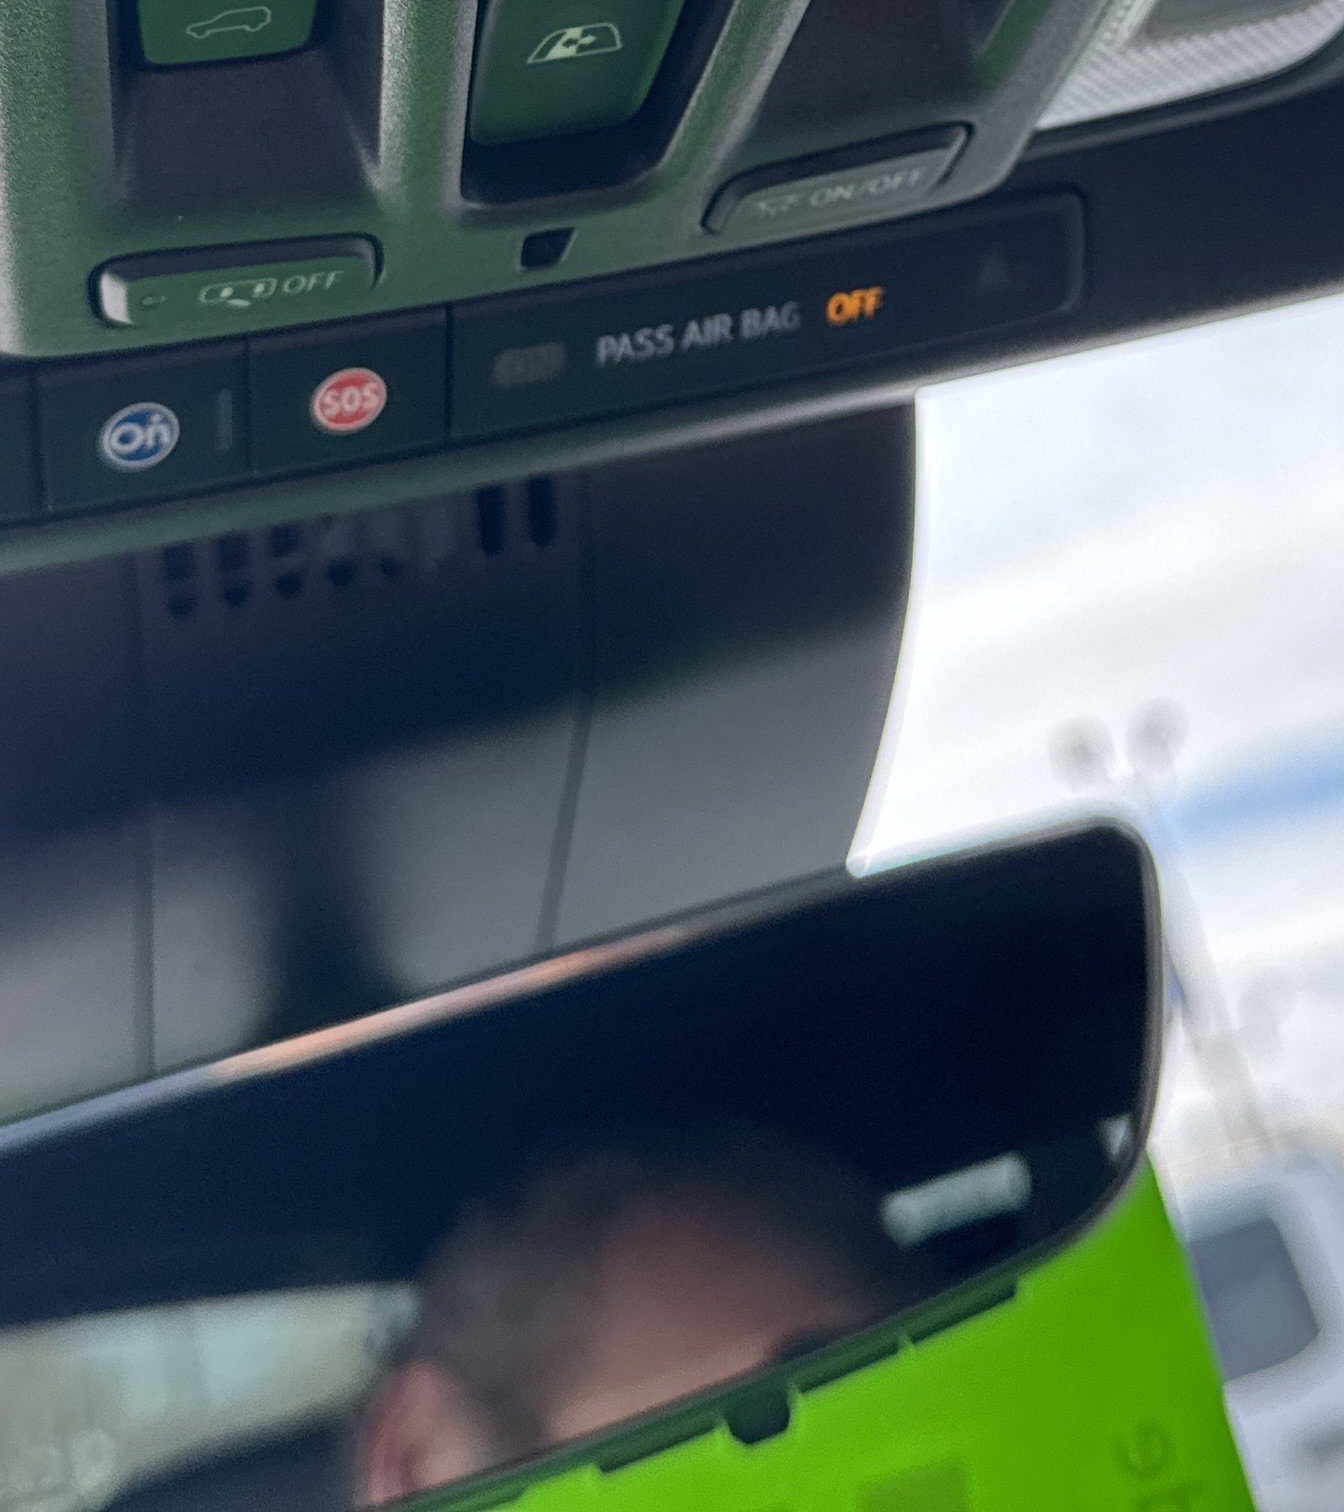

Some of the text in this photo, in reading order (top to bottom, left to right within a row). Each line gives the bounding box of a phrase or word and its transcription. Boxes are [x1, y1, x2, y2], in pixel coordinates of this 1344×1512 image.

[281, 269, 345, 296] OFF
[594, 286, 885, 366] PASS AIR BAG OFF
[319, 380, 382, 417] SOS
